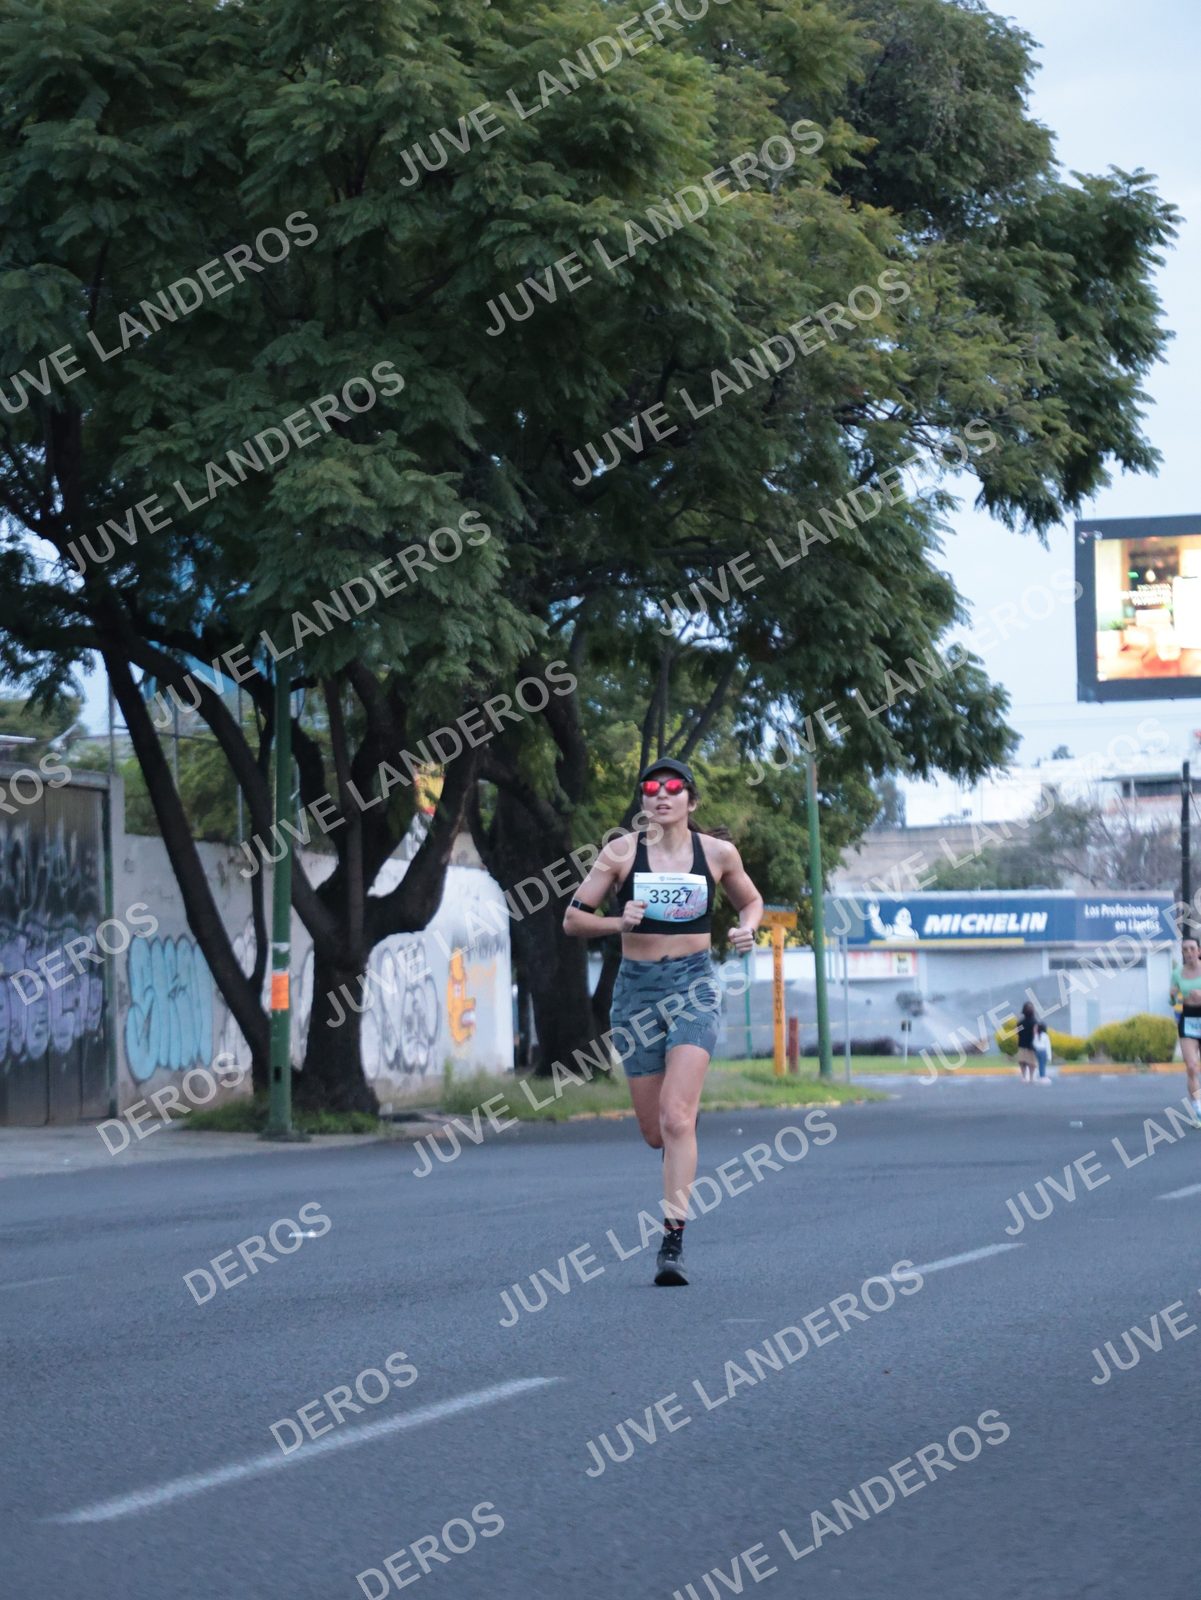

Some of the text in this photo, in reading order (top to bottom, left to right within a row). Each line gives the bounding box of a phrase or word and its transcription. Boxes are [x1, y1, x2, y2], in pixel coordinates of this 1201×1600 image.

[649, 889, 692, 904] 3327
[1084, 904, 1100, 918] Los
[924, 911, 1048, 934] MICHELIN
